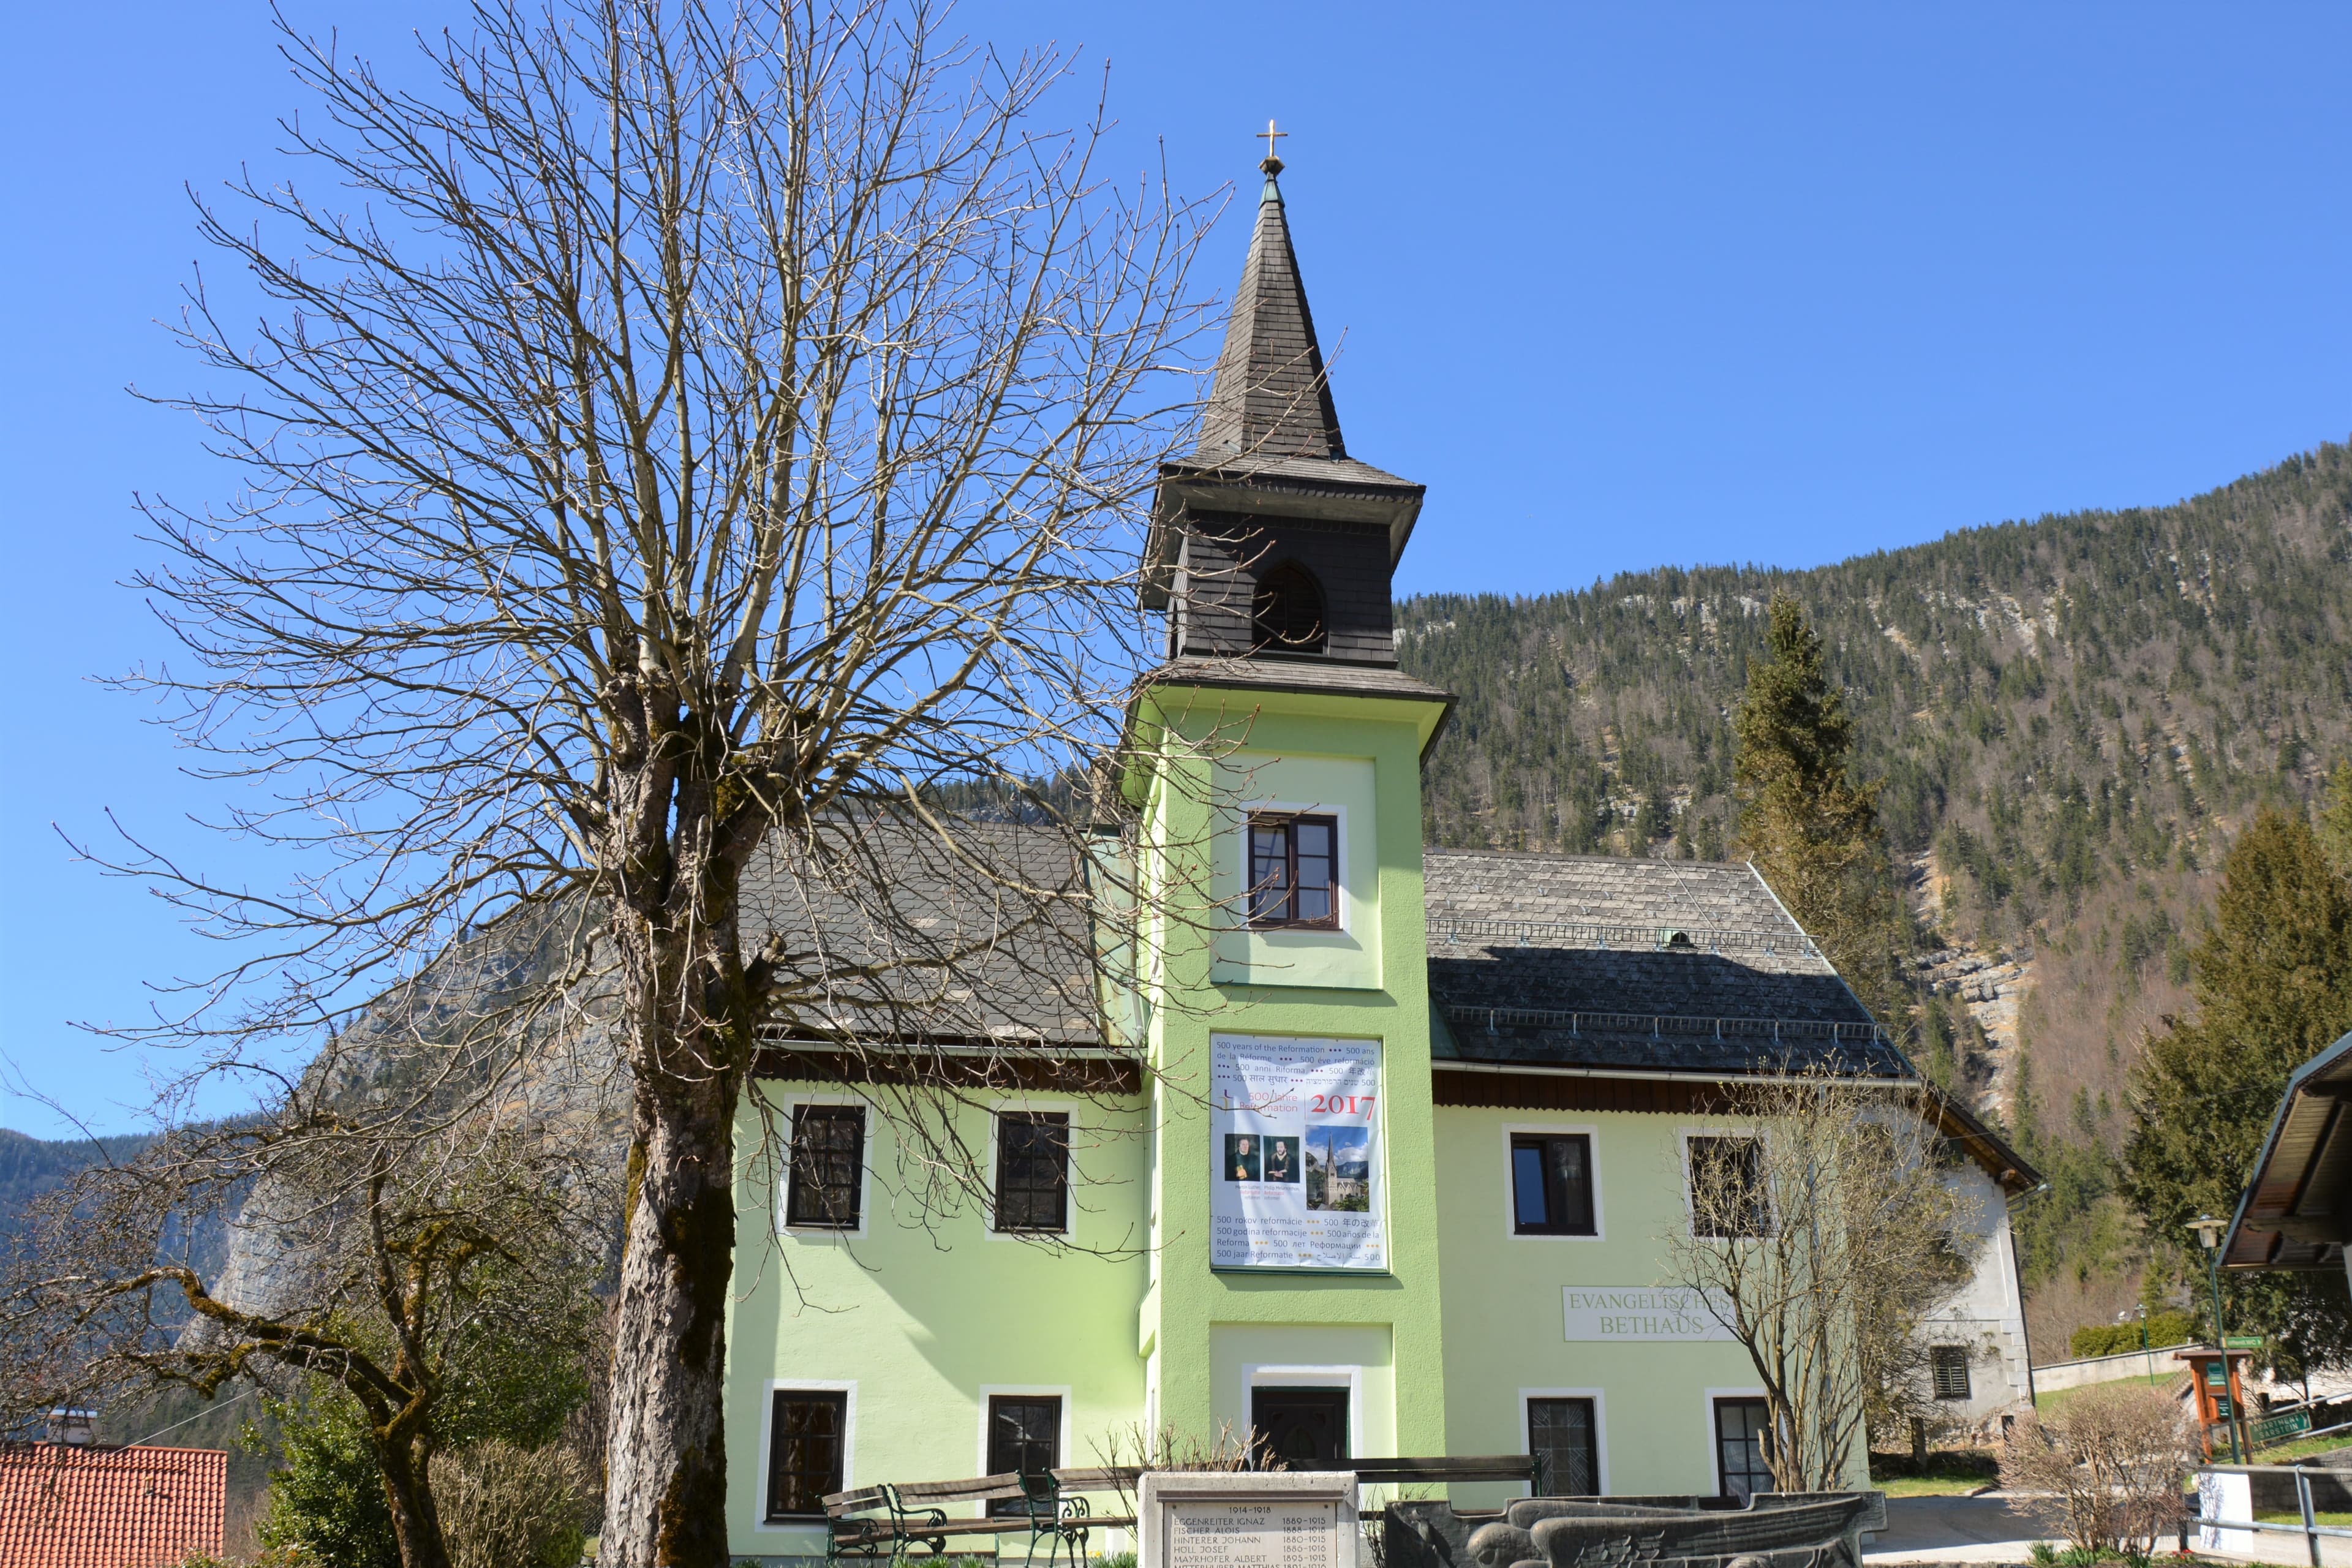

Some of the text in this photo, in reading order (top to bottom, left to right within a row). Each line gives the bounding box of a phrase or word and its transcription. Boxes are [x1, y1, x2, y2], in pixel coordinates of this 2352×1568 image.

[1240, 1054, 1272, 1062] Réforme
[1274, 1093, 1297, 1101] Jahre
[1311, 1094, 1376, 1120] 2017
[1233, 1227, 1260, 1236] godina
[1262, 1228, 1307, 1237] reformacije
[1310, 1241, 1360, 1250] Реформации
[1569, 1294, 1730, 1309] EVANGELISCHES
[1600, 1317, 1703, 1334] BETHAUS
[2254, 1414, 2299, 1431] APARTMENT
[2259, 1423, 2298, 1439] SARSTEIN
